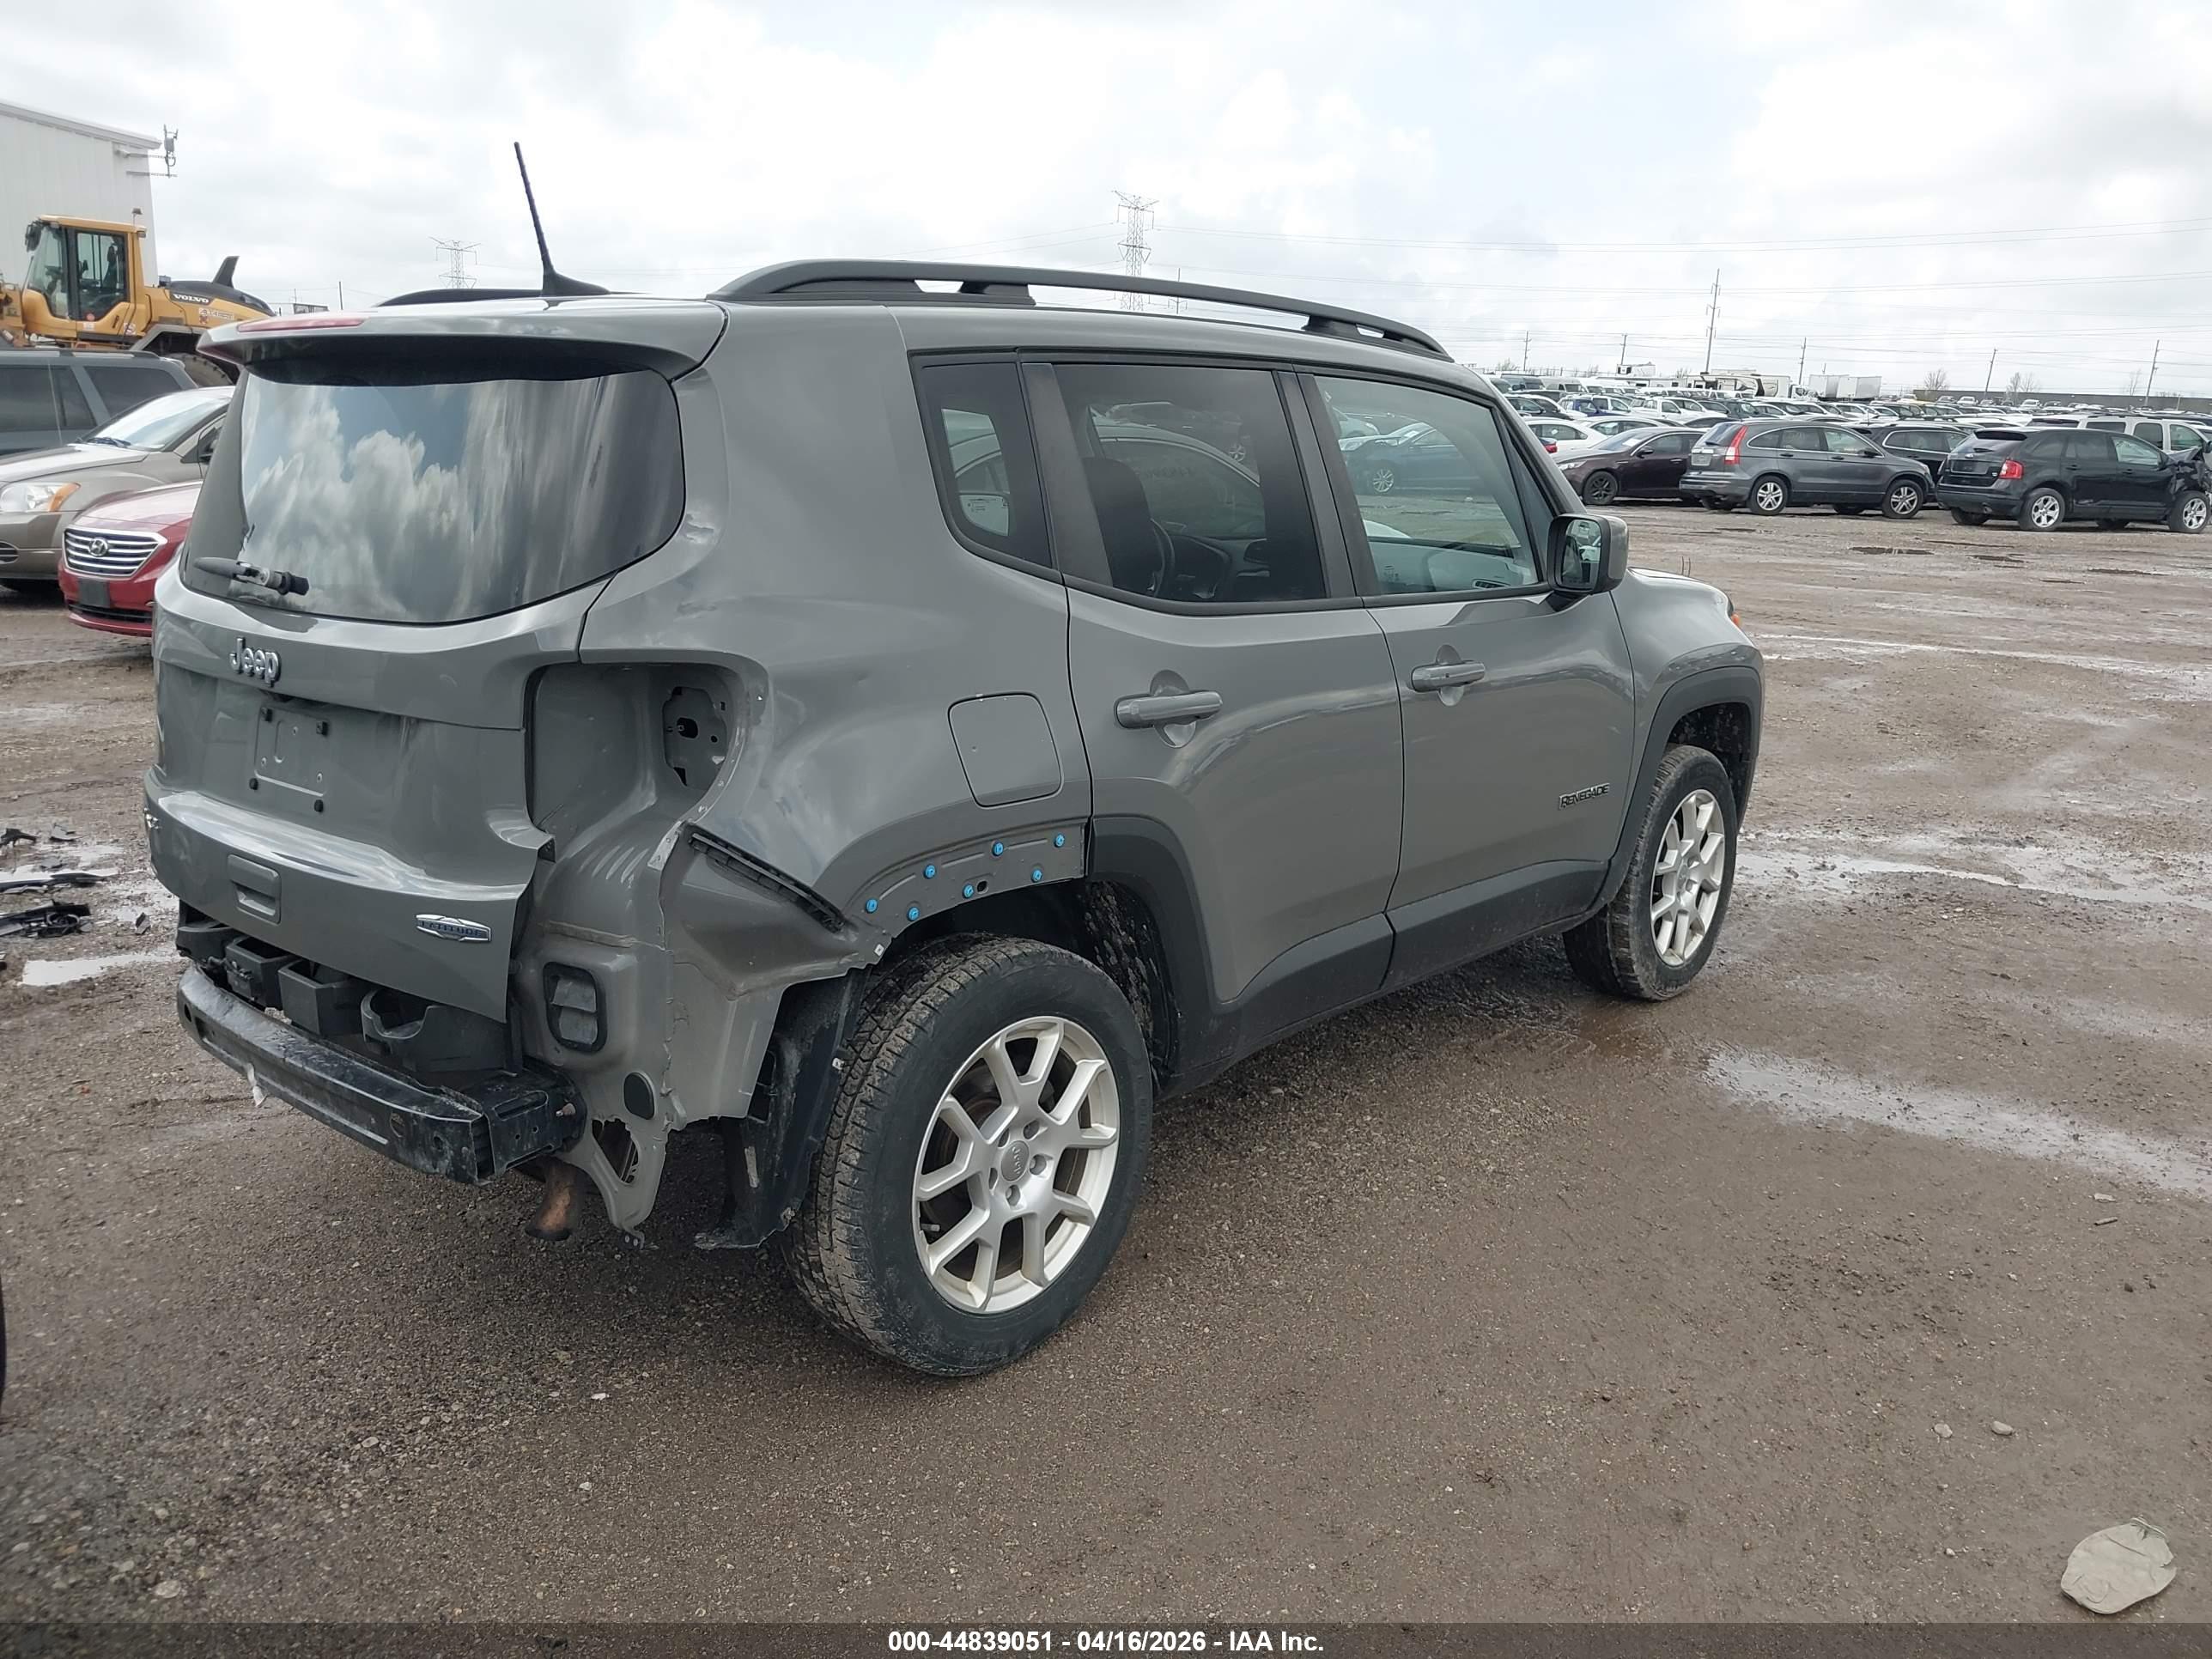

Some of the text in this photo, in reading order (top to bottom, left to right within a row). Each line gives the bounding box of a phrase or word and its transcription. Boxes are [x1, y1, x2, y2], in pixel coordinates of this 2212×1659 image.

[173, 294, 210, 304] VOLVO
[228, 637, 280, 684] Jeep
[1559, 782, 1610, 809] RENEGADE
[420, 920, 483, 937] LATITUDE
